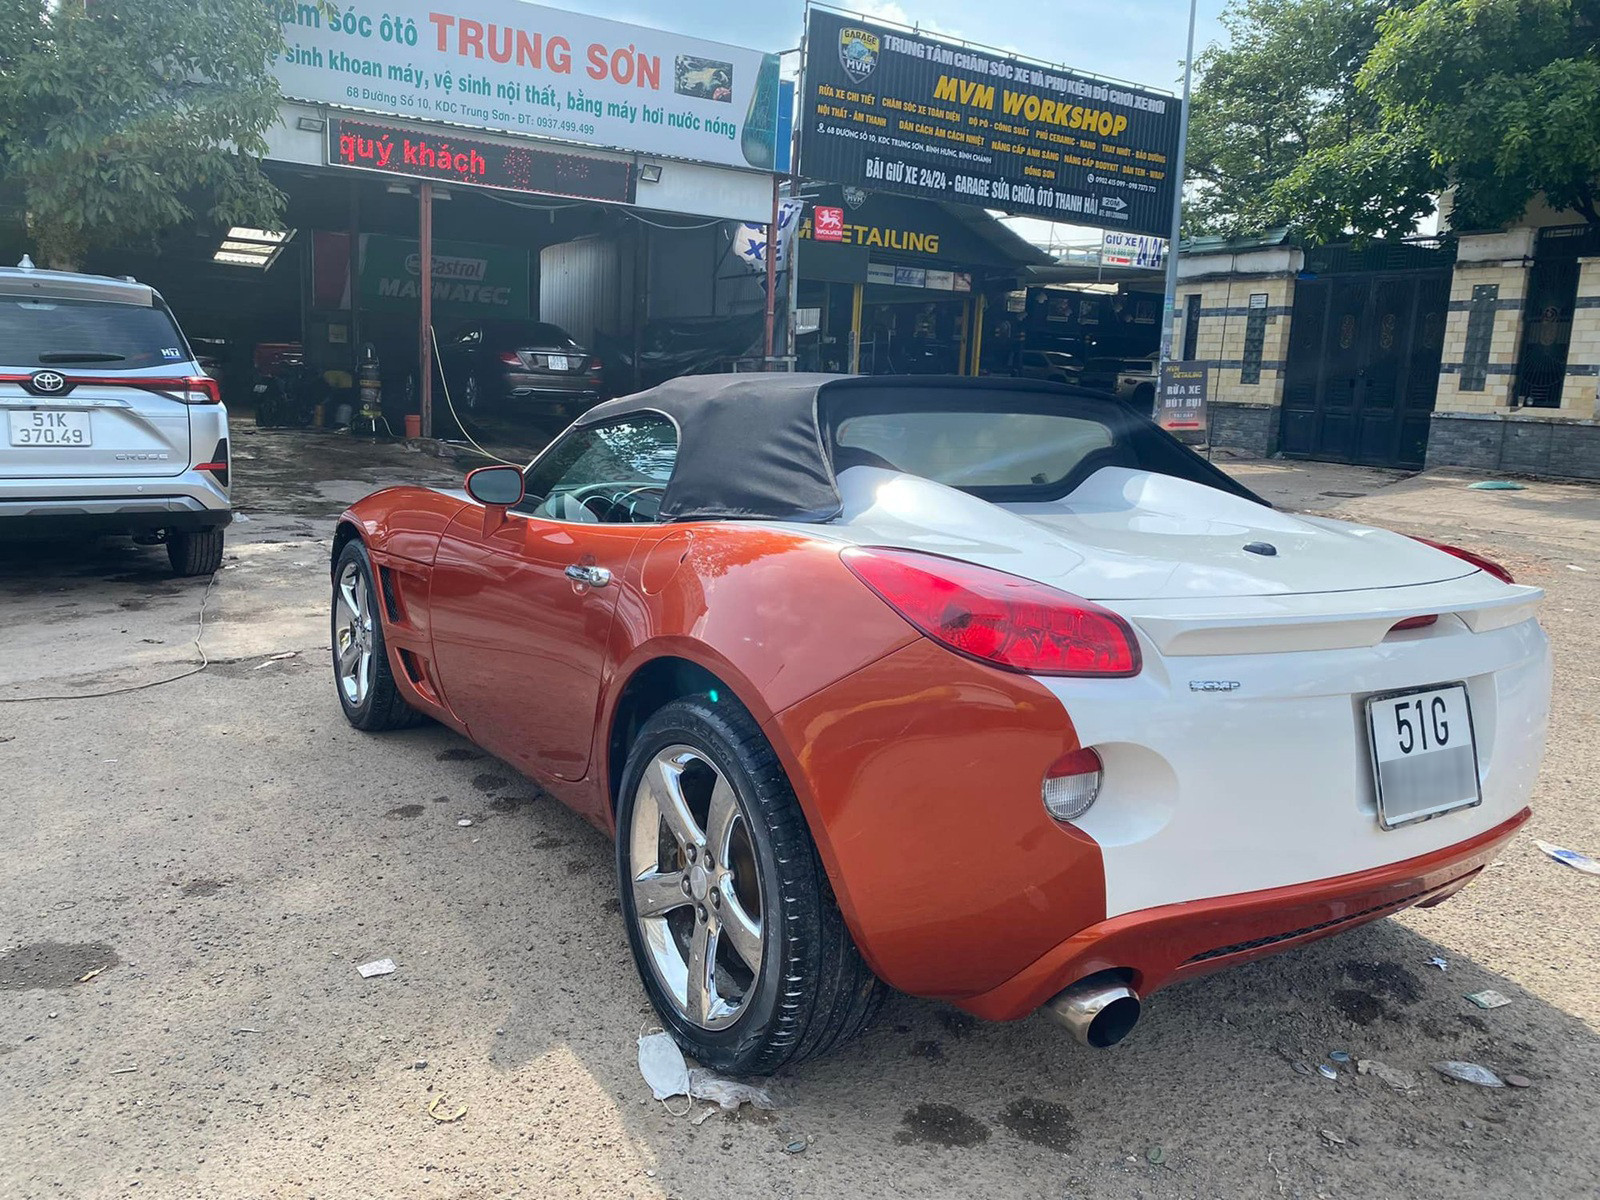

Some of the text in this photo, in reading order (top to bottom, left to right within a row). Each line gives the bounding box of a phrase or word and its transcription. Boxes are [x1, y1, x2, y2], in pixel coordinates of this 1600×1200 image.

[844, 29, 878, 45] GARAGE
[380, 13, 417, 46] ôtô
[429, 12, 572, 74] TRUNG
[586, 43, 661, 90] SƠN
[846, 59, 871, 73] MVM
[883, 34, 924, 58] TRUNG
[926, 44, 953, 66] TÂM
[954, 54, 989, 75] CHĂM
[990, 60, 1013, 80] SÓC
[1014, 67, 1030, 84] XE
[1030, 69, 1044, 88] VÀ
[1110, 92, 1134, 108] CHƠI
[1134, 97, 1148, 111] XE
[286, 43, 323, 68] sinh
[329, 49, 382, 78] khoan
[388, 63, 429, 90] máy,
[434, 71, 453, 96] vệ
[458, 73, 492, 97] sinh
[498, 80, 520, 106] nội
[526, 84, 561, 112] thất,
[567, 88, 602, 118] bằng
[607, 101, 637, 124] máy
[643, 104, 664, 125] hơi
[668, 110, 701, 131] nước
[705, 116, 737, 140] nóng
[818, 84, 876, 106] RỬA XE CHI TIẾT
[346, 86, 359, 98] 68
[362, 88, 397, 106] Đường
[400, 94, 414, 108] Số
[417, 98, 432, 111] 10,
[436, 102, 457, 114] KDC
[460, 105, 488, 122] Trung
[492, 109, 510, 122] Sơn
[518, 114, 534, 126] ĐT:
[536, 116, 595, 136] 0937.499.499
[818, 104, 830, 116] NỘI
[831, 106, 848, 119] THẤT
[866, 114, 887, 128] THANH
[903, 100, 917, 114] SÓC
[918, 106, 928, 116] XE
[934, 74, 1128, 137] MVM WORKSHOP
[826, 126, 836, 135] 68
[878, 136, 890, 146] KDC
[891, 138, 912, 150] TRUNG
[915, 121, 934, 136] CÁCH
[947, 128, 965, 142] CÁCH
[1050, 132, 1076, 146] CERAMIC
[339, 134, 486, 175] quý khách
[866, 157, 883, 178] BÃI
[886, 161, 904, 182] GIỮ
[904, 166, 918, 184] XE
[920, 168, 947, 190] 24/24
[954, 175, 990, 198] GARAGE
[992, 176, 1010, 201] SỬA
[1011, 182, 1035, 204] CHỮA
[1038, 186, 1053, 208] ÔTÔ
[1055, 192, 1082, 212] THANH
[1084, 193, 1099, 216] HẢI
[1105, 199, 1121, 207] 20M
[842, 224, 939, 254] ETAILING
[1106, 233, 1123, 246] GIỮ
[1125, 238, 1138, 247] XE
[378, 278, 508, 304] MANATEC
[1167, 384, 1201, 395] RỬA XE
[1165, 398, 1202, 408] HÚT BỤI
[32, 413, 67, 427] 51K
[20, 429, 83, 444] 370.49
[115, 453, 168, 461] CROSS
[1394, 696, 1450, 755] 51G
